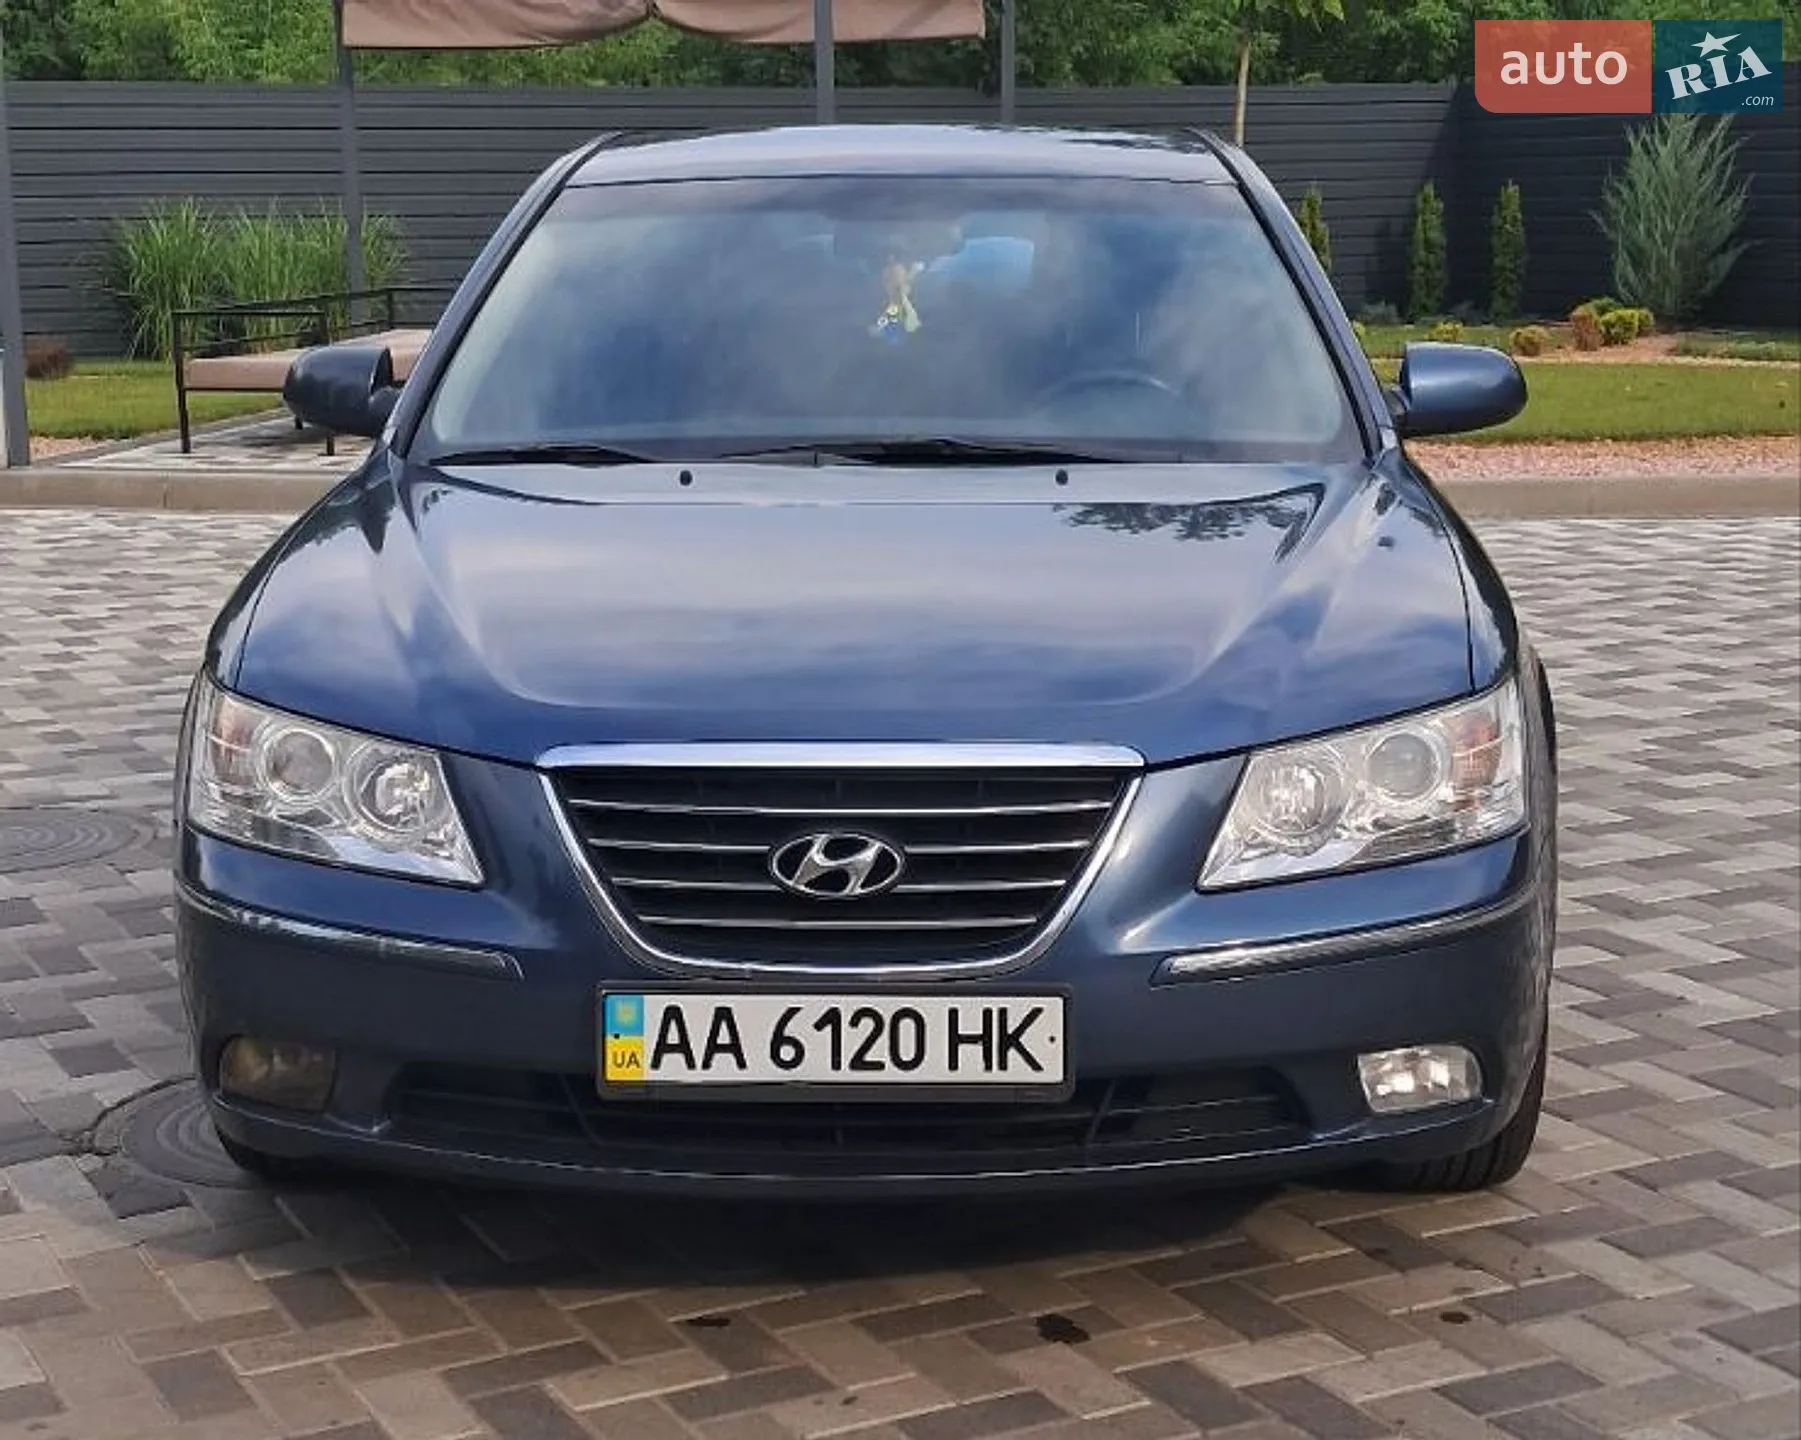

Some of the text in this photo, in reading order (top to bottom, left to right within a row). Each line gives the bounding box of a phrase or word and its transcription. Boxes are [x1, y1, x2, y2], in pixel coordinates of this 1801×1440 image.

[650, 1004, 1045, 1072] AA 6120 HK
[612, 1051, 641, 1069] UA
